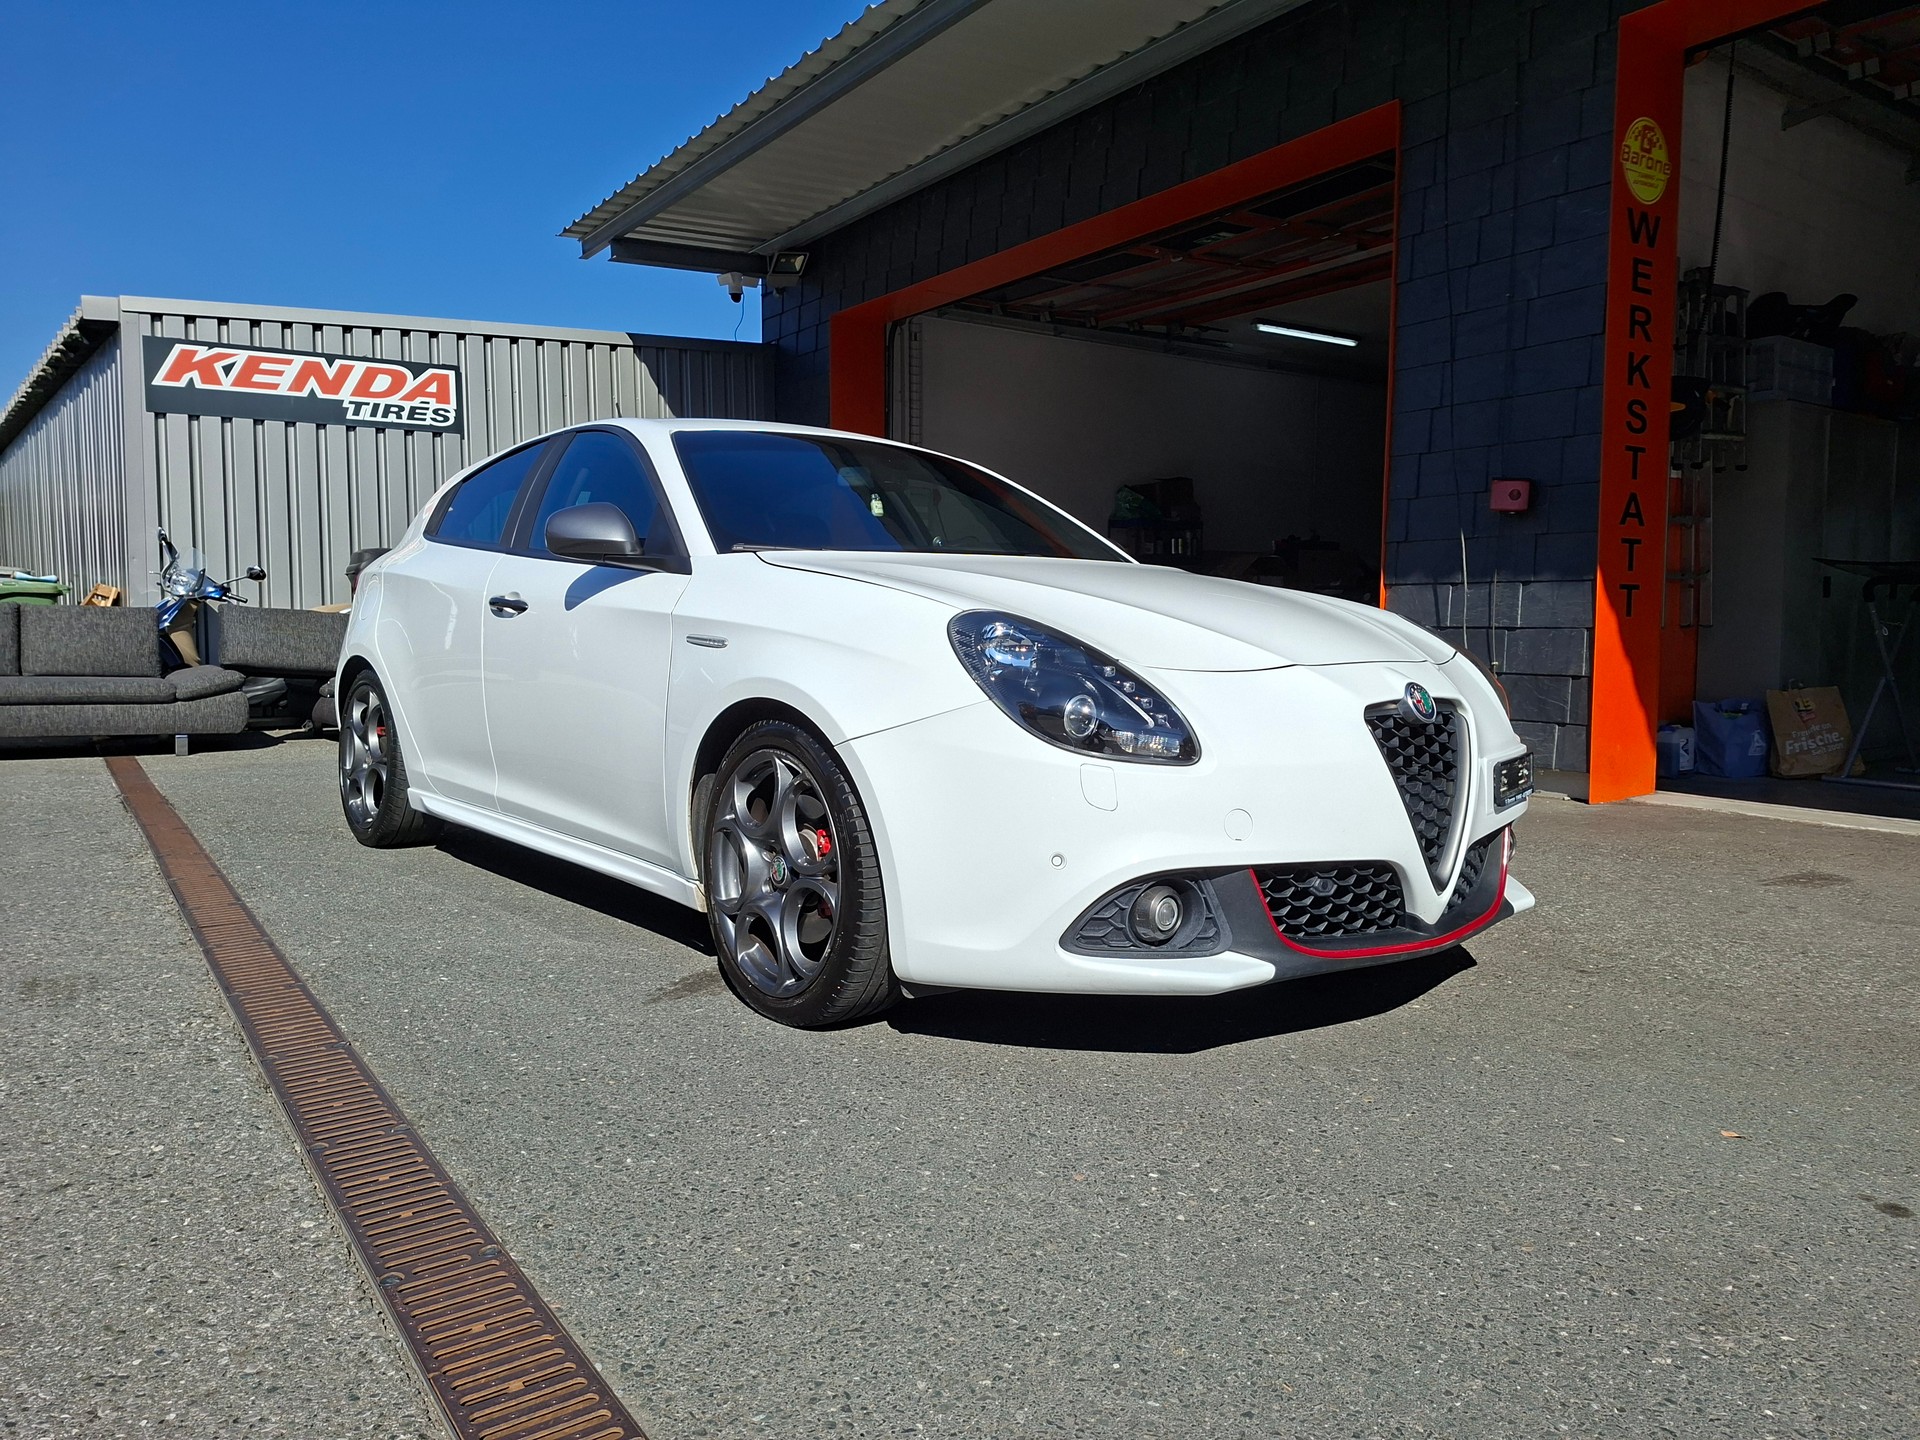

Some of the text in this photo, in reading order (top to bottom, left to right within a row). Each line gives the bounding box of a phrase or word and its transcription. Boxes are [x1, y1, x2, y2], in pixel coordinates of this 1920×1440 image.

[1622, 144, 1671, 176] Barone
[154, 344, 455, 405] KENDA
[349, 401, 455, 425] TIRES
[1619, 207, 1662, 618] WERKSTATT
[1785, 731, 1844, 755] Frische.
